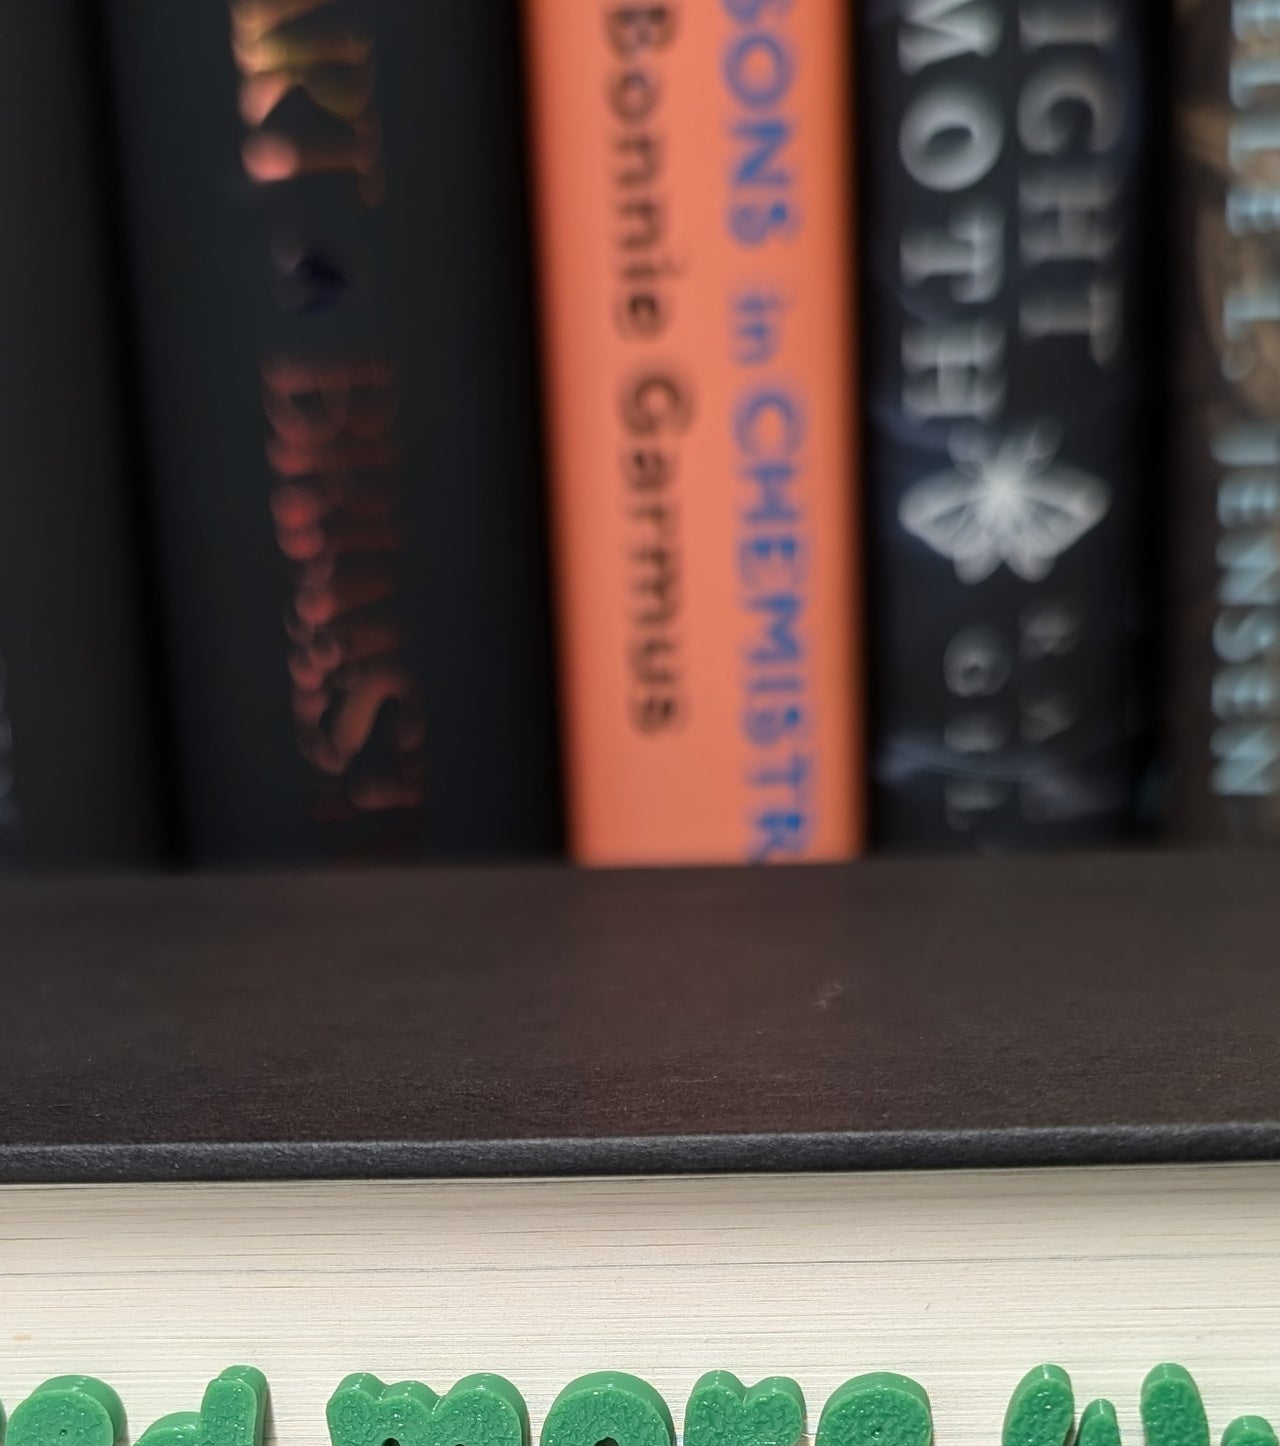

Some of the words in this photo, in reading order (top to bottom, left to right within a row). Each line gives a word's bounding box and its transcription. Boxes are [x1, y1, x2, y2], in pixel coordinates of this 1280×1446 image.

[604, 3, 688, 342] Bonnie
[732, 292, 790, 369] in
[620, 375, 697, 739] Garmus
